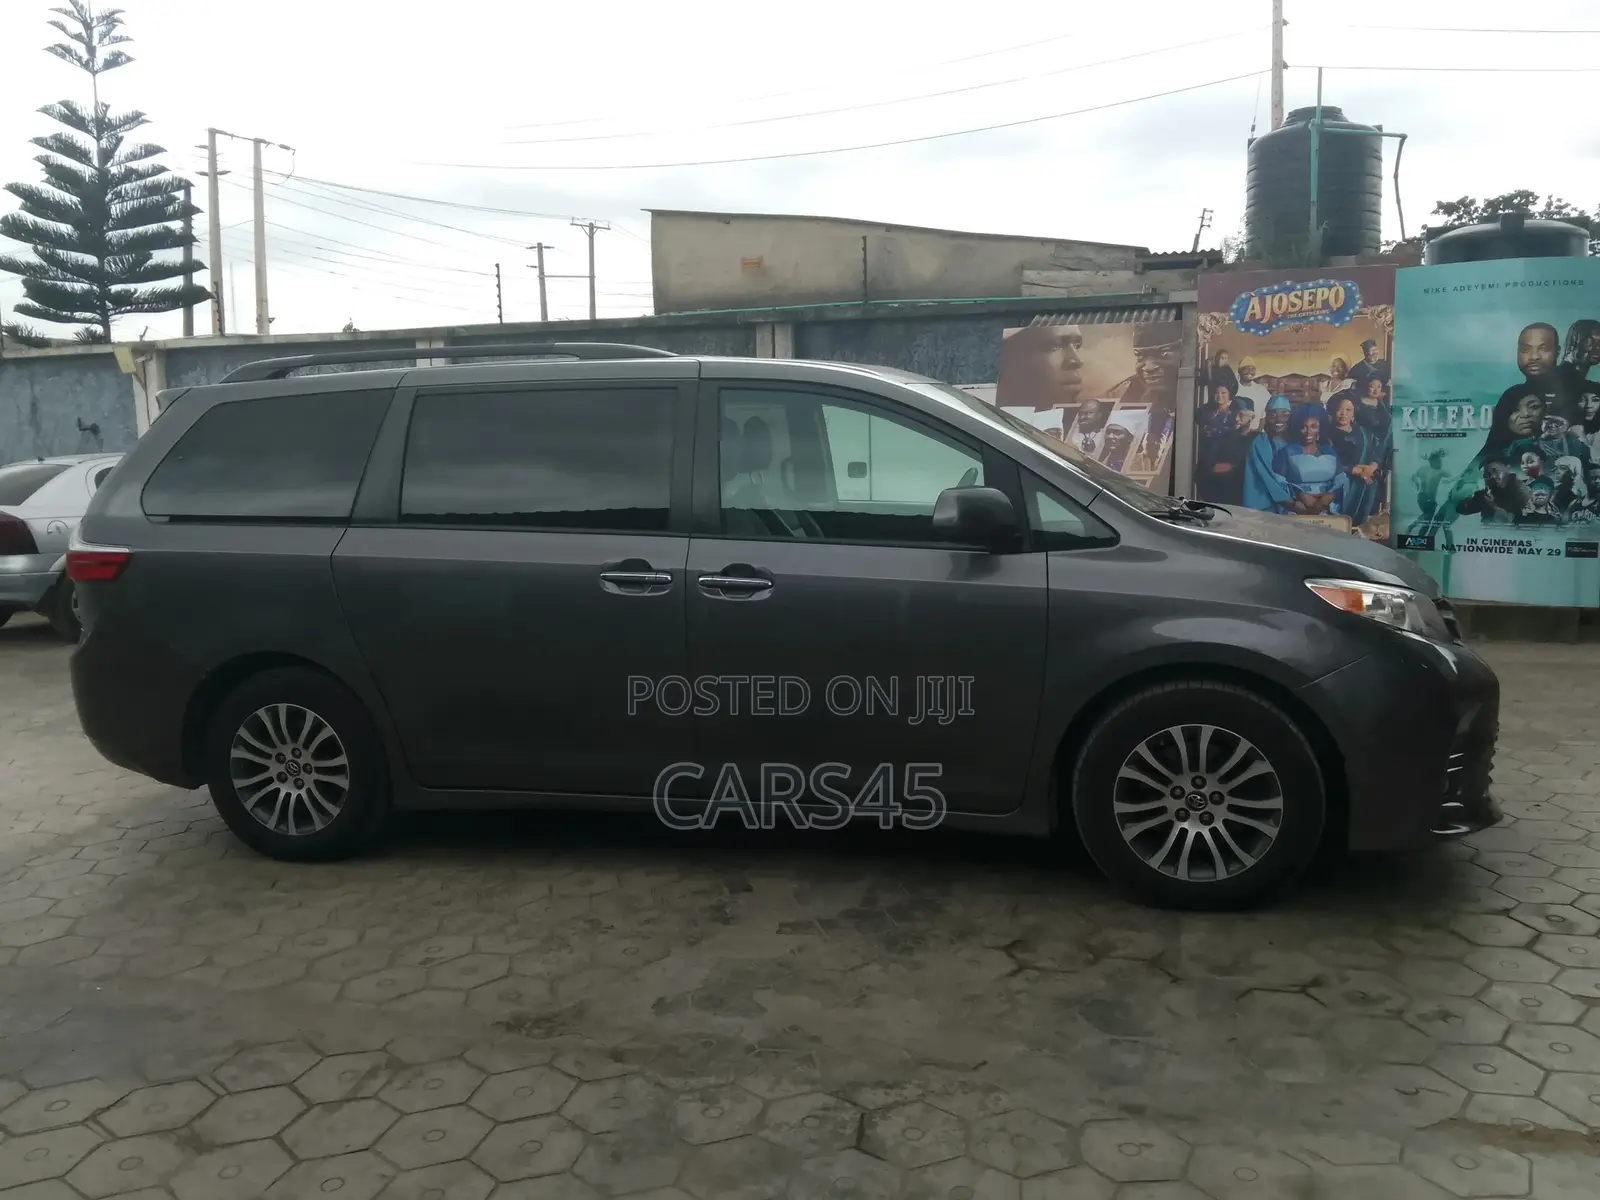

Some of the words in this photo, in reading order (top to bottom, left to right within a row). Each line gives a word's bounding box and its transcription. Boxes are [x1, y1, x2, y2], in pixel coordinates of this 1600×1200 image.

[1423, 286, 1447, 294] MIKE
[1453, 283, 1499, 292] ADEYEMI
[1505, 279, 1584, 289] PRODUCTIONS
[1401, 405, 1493, 431] KOLERO
[1466, 537, 1478, 545] IN
[1481, 538, 1533, 547] CINEMAS
[1442, 543, 1513, 554] NATIONWIDE
[1517, 547, 1543, 556] MAY
[1547, 548, 1561, 556] 29
